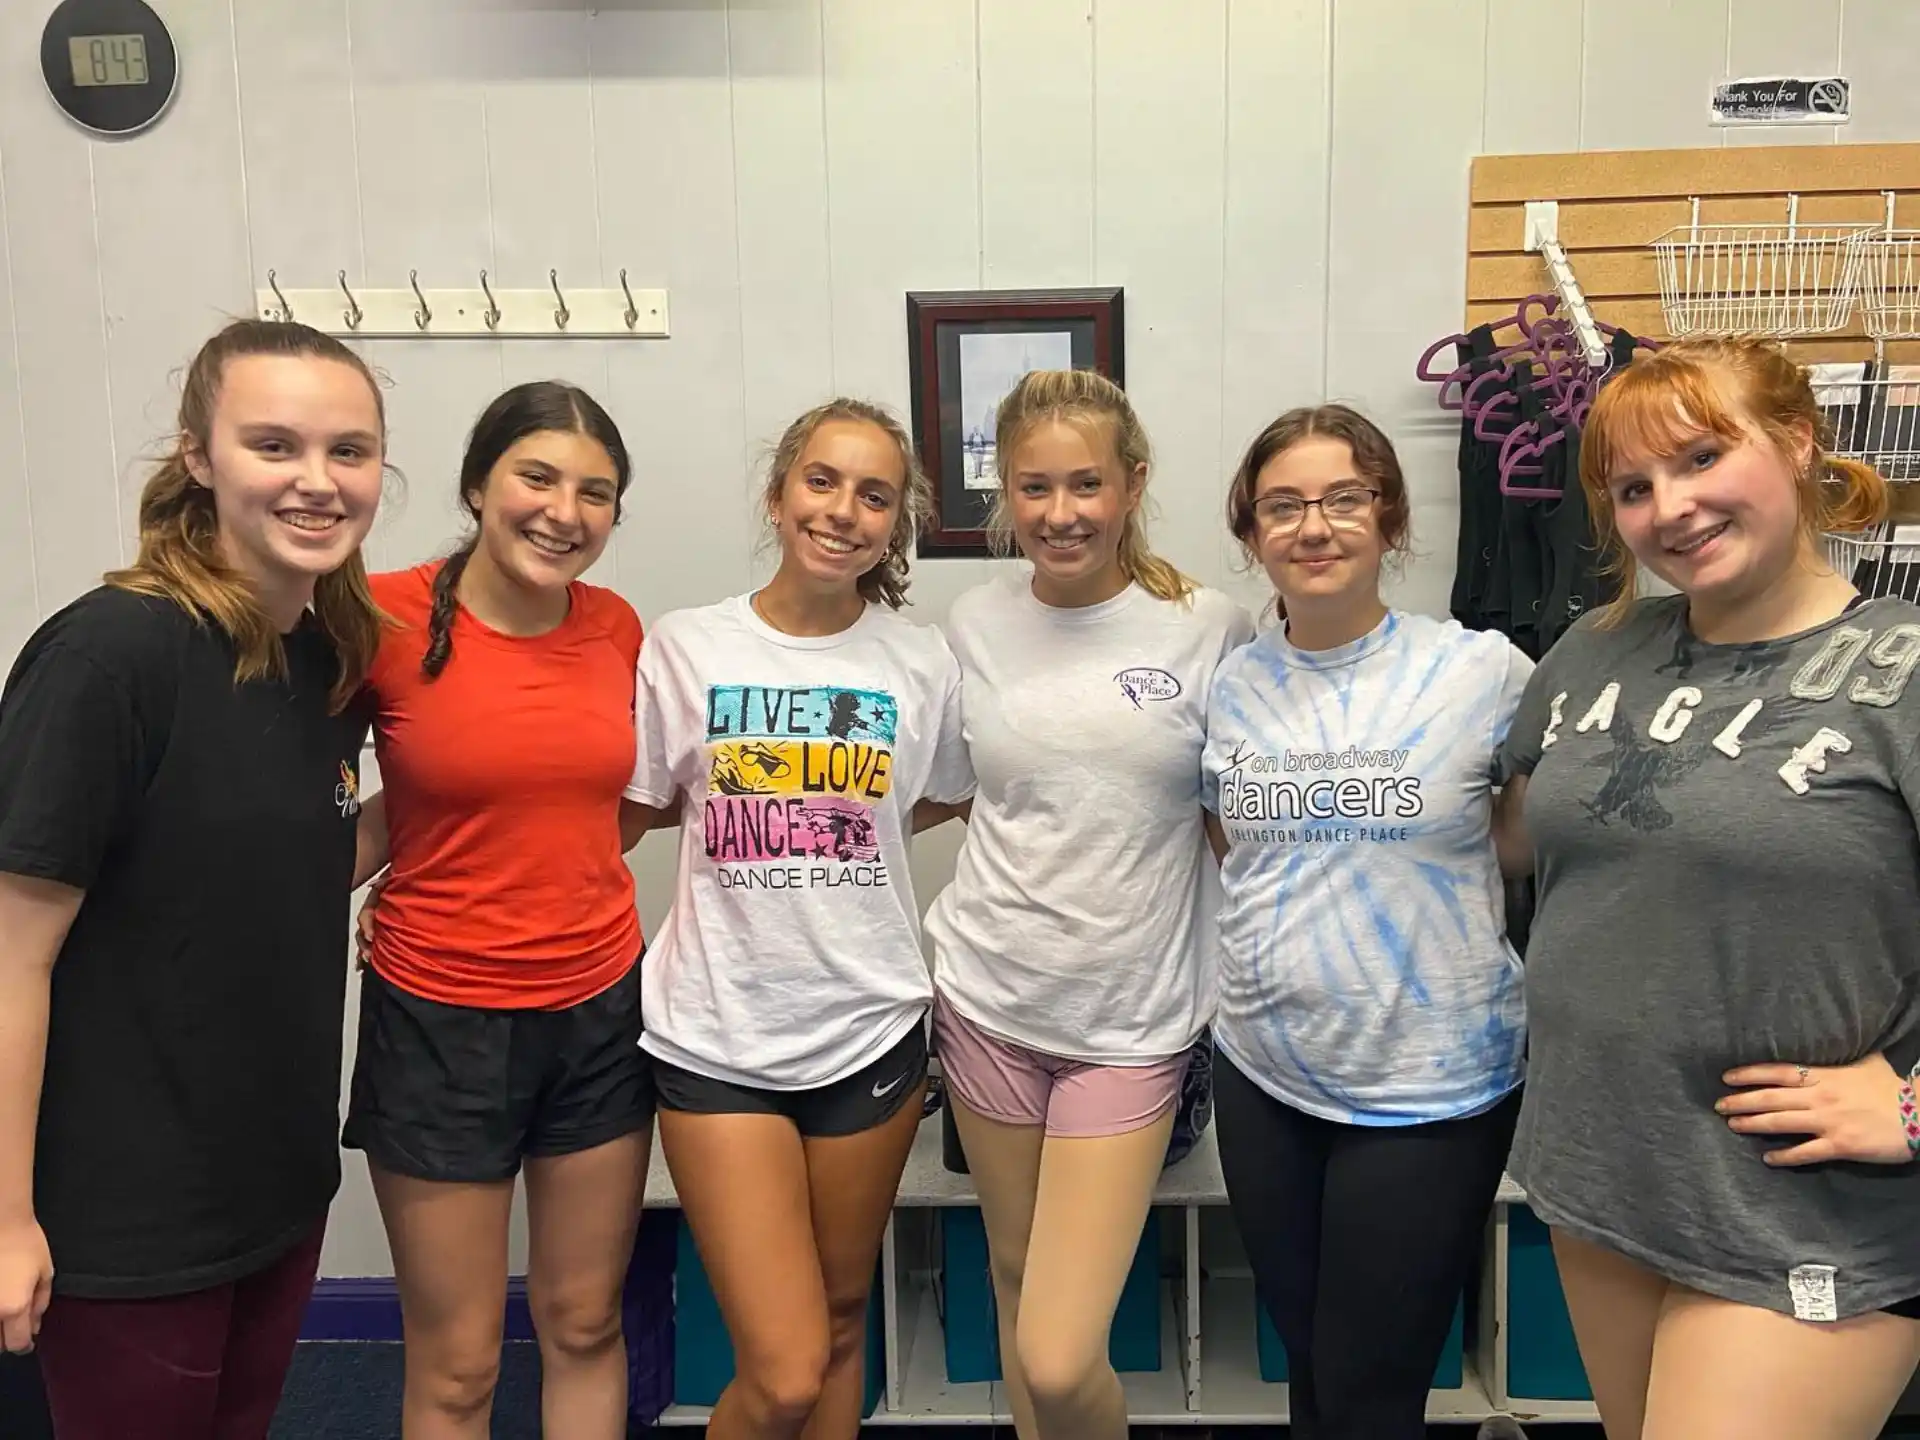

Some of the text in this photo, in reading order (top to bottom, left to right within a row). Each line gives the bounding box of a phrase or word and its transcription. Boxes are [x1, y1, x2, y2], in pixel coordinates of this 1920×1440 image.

[1715, 89, 1798, 103] hank You For
[1120, 673, 1157, 685] Dance
[1140, 683, 1171, 696] Place
[708, 686, 810, 735] LIVE
[802, 741, 892, 799] LOVE
[1251, 745, 1408, 773] on broadway
[1223, 769, 1423, 820] dancers
[704, 798, 806, 858] DANCE
[1304, 828, 1351, 842] DANCE
[1360, 827, 1408, 841] PLACE
[718, 866, 888, 890] DANCE PLACE
